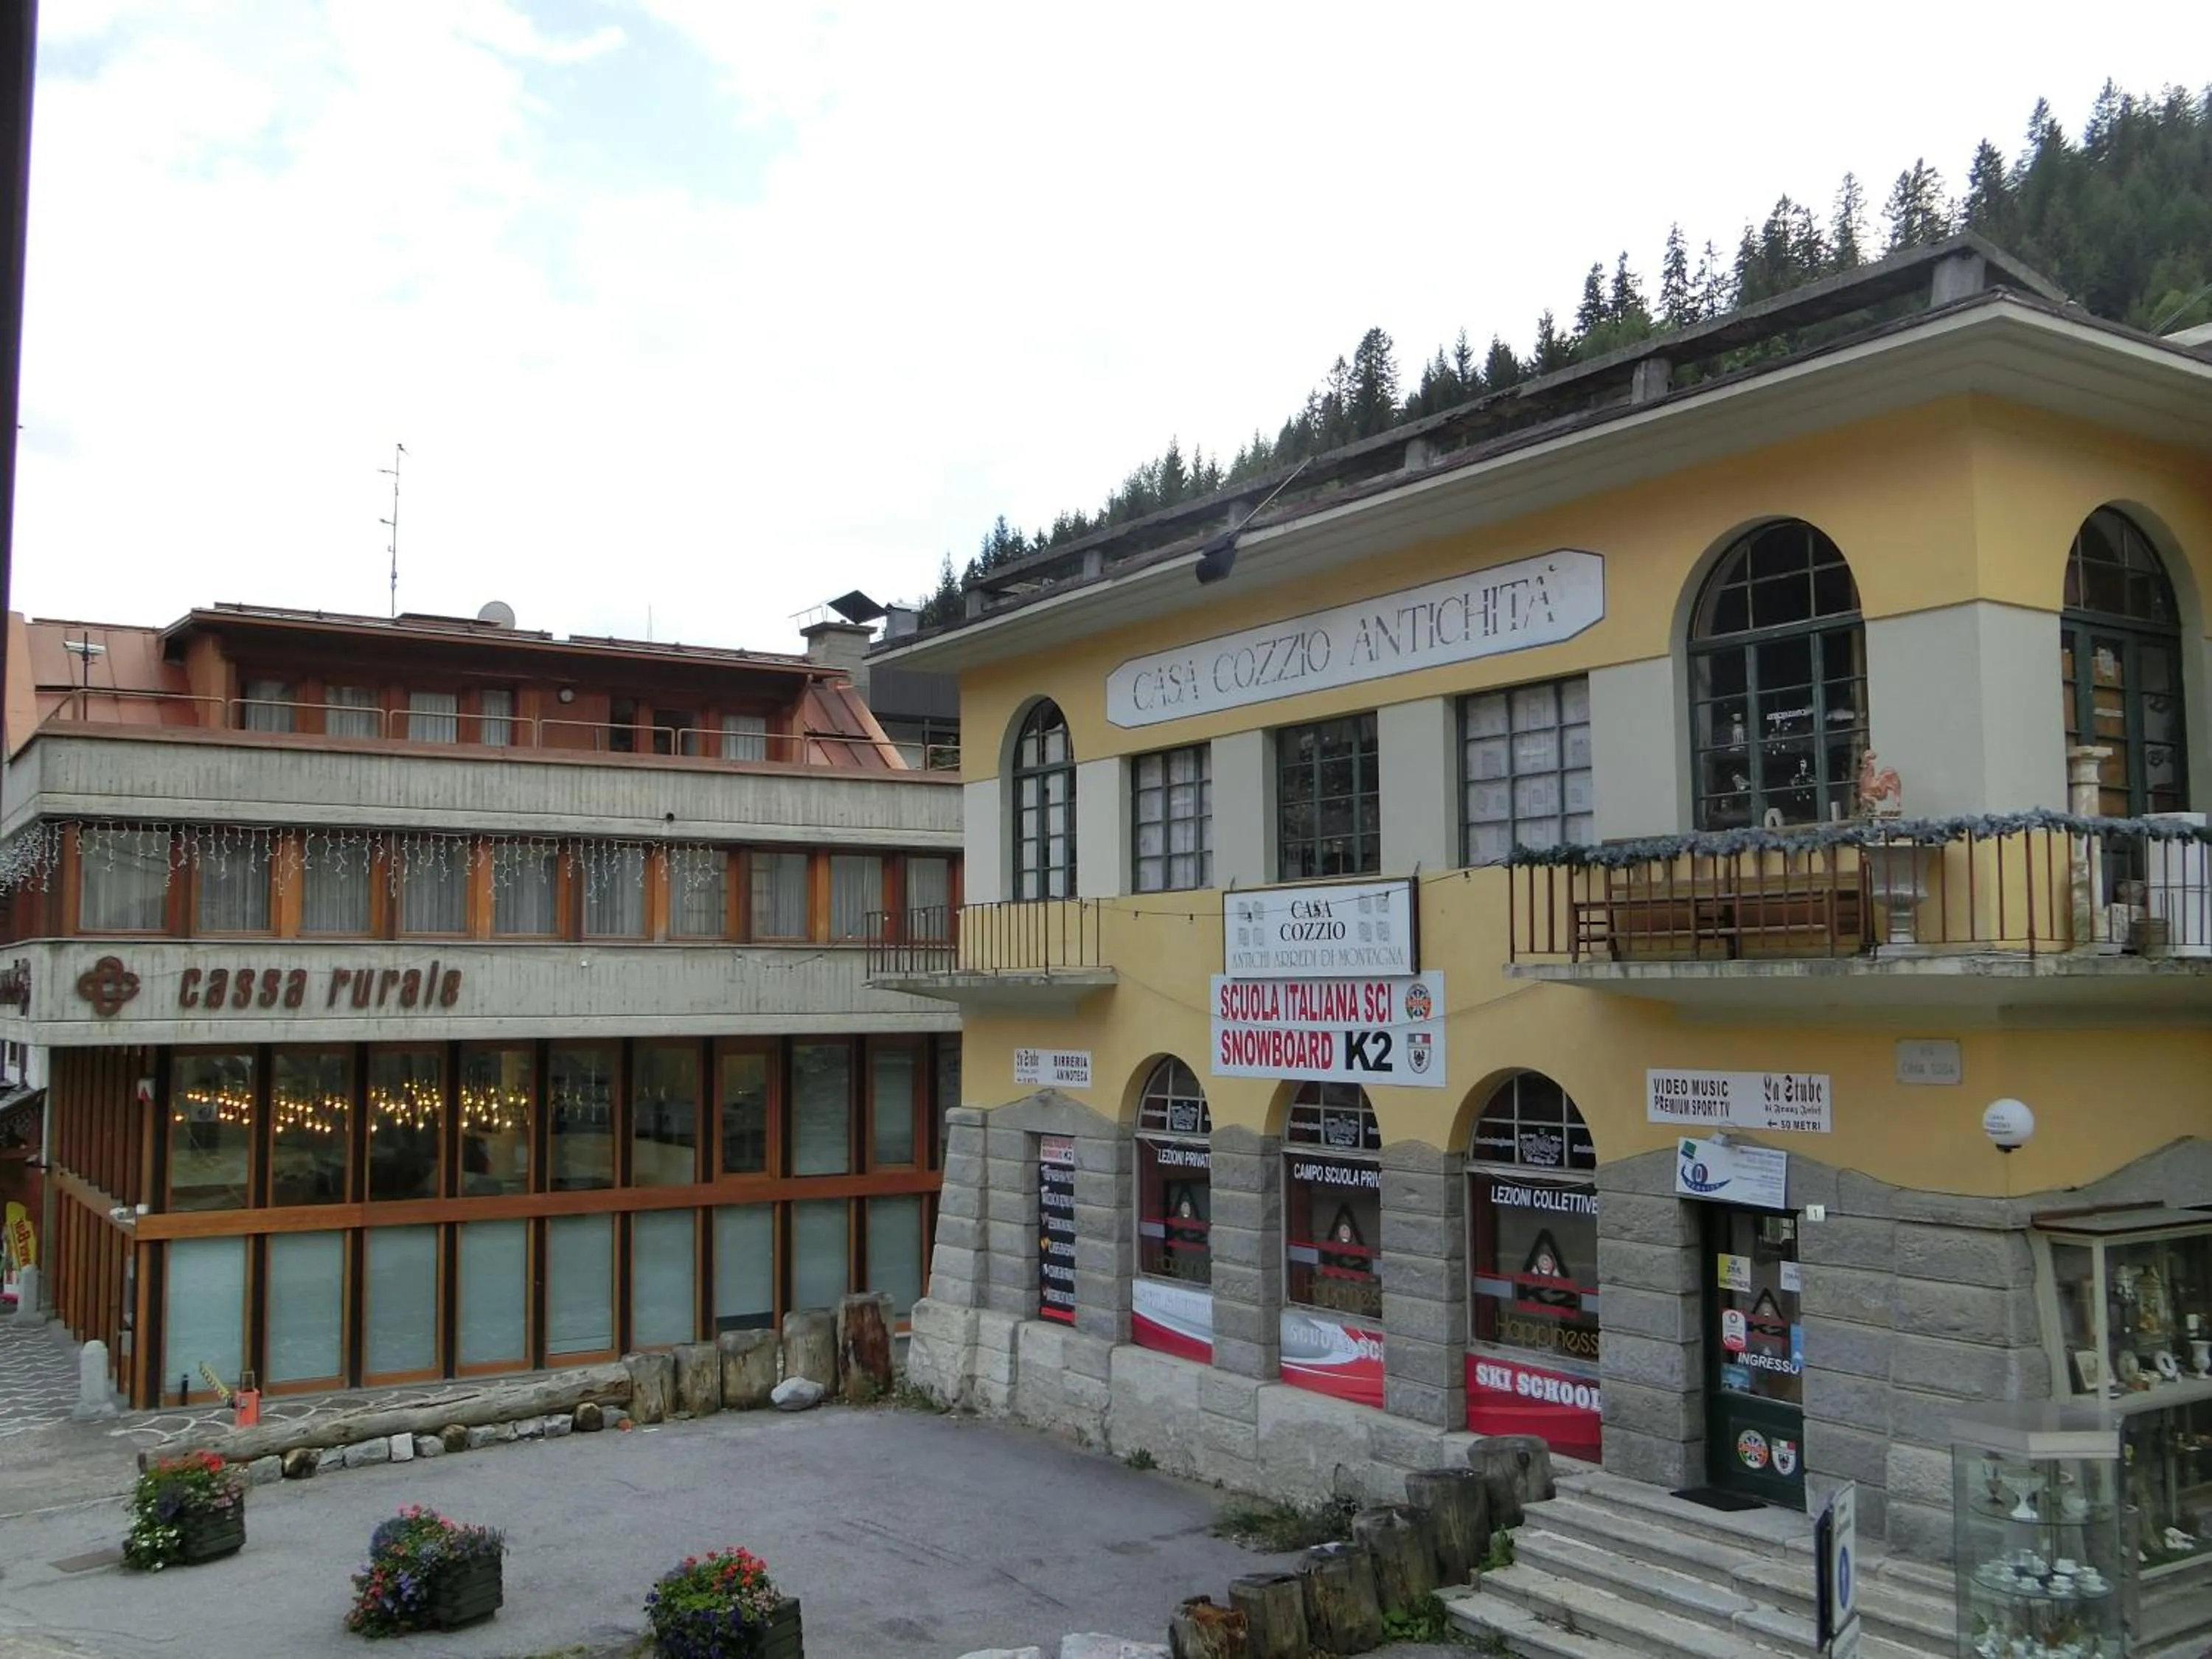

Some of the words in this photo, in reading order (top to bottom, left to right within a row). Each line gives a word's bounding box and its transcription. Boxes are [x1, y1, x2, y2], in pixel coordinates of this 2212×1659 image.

[1133, 658, 1198, 711] CASA
[1213, 630, 1332, 695] COZZIO
[1290, 900, 1333, 919] CASA
[1280, 922, 1346, 942] COZZIO
[1232, 952, 1270, 969] ANTICHI
[1274, 950, 1318, 969] ARREDI
[1321, 950, 1335, 967] DI
[1338, 947, 1405, 967] MONTAGNA
[178, 967, 308, 1009] cassa
[325, 960, 462, 1009] rurale
[1220, 984, 1281, 1021] SCUOLA
[1284, 984, 1360, 1023] ITALIANA
[1364, 982, 1393, 1023] SCI
[1221, 1029, 1334, 1070] SNOWBOARD
[1345, 1031, 1393, 1072] K2
[1653, 1078, 1688, 1095] VIDEO
[1692, 1079, 1729, 1098] MUSIC
[1653, 1095, 1689, 1116] PREMIUM
[1692, 1099, 1718, 1117] SPORT
[1719, 1101, 1730, 1117] TV
[1793, 1120, 1820, 1130] METRI
[1294, 1162, 1324, 1182] CAMPO
[1325, 1165, 1359, 1186] SCUOLA
[1491, 1185, 1531, 1207] LEZIONI
[1533, 1189, 1599, 1214] COLLETTIVE
[1737, 1352, 1800, 1374] INGRESSO
[1475, 1363, 1512, 1392] SKI
[1516, 1371, 1602, 1414] SCHOOL
